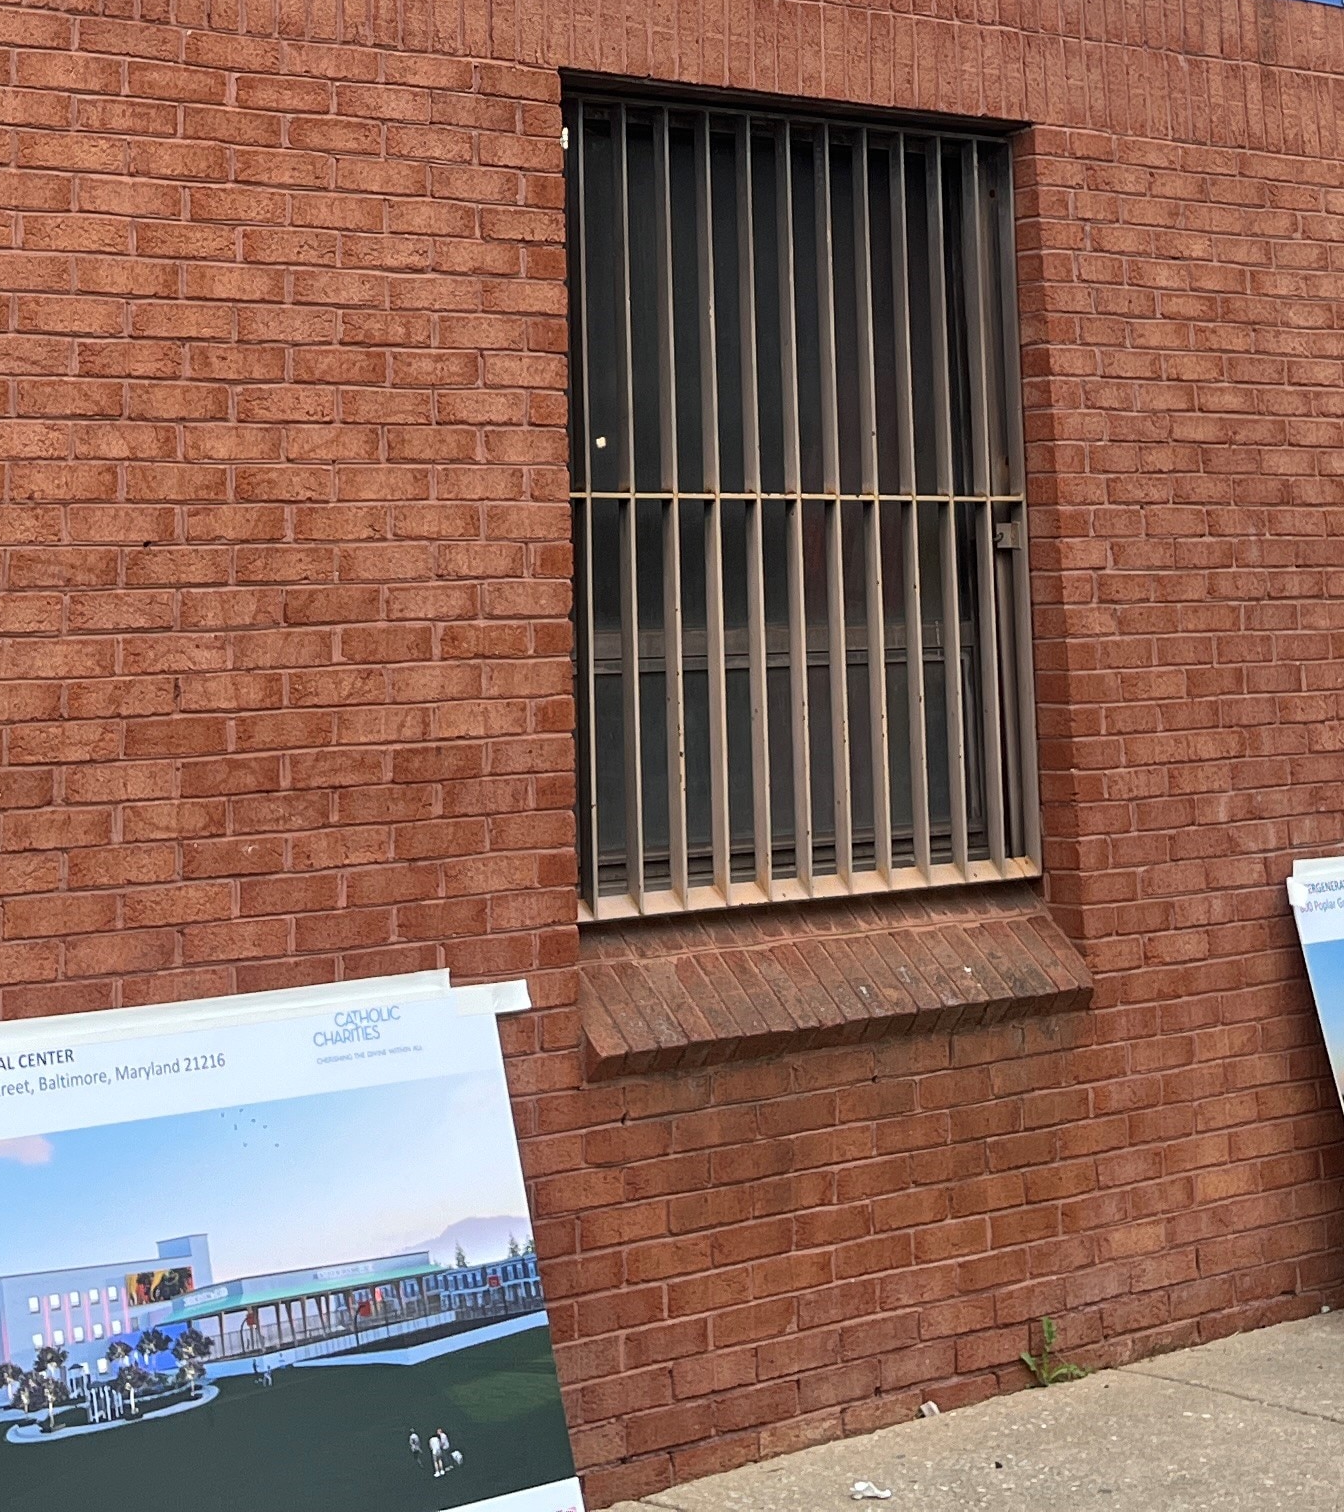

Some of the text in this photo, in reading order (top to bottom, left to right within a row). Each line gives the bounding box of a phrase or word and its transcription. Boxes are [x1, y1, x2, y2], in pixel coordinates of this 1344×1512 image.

[1314, 898, 1335, 913] Poplar
[334, 1005, 401, 1027] CATHOLIC
[18, 1048, 74, 1070] CENTER
[39, 1070, 112, 1092] Baltimore,
[115, 1058, 181, 1083] Maryland
[184, 1052, 226, 1072] 21216
